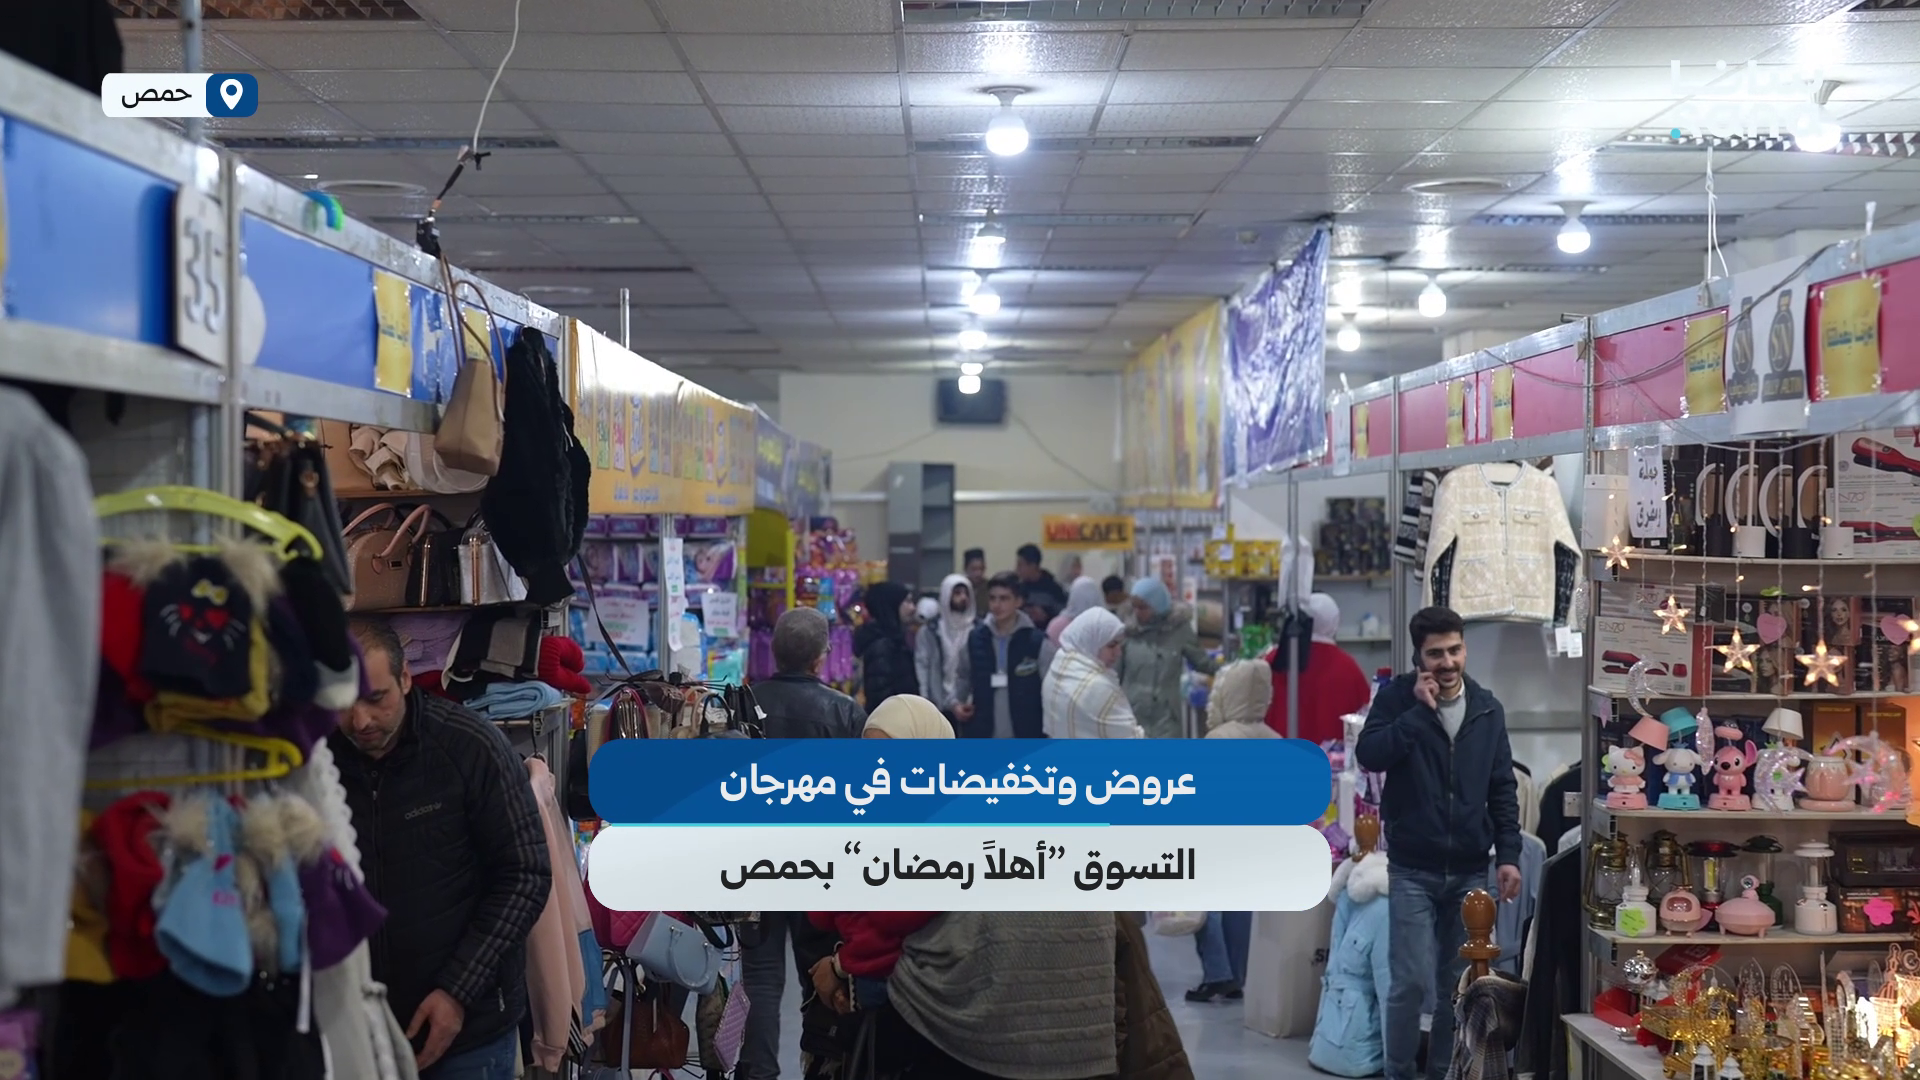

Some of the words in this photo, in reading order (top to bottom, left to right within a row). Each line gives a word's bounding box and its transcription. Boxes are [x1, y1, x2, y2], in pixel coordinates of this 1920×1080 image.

[183, 216, 225, 335] 35
[1045, 520, 1129, 543] UNICAFE
[405, 805, 433, 819] adidas
